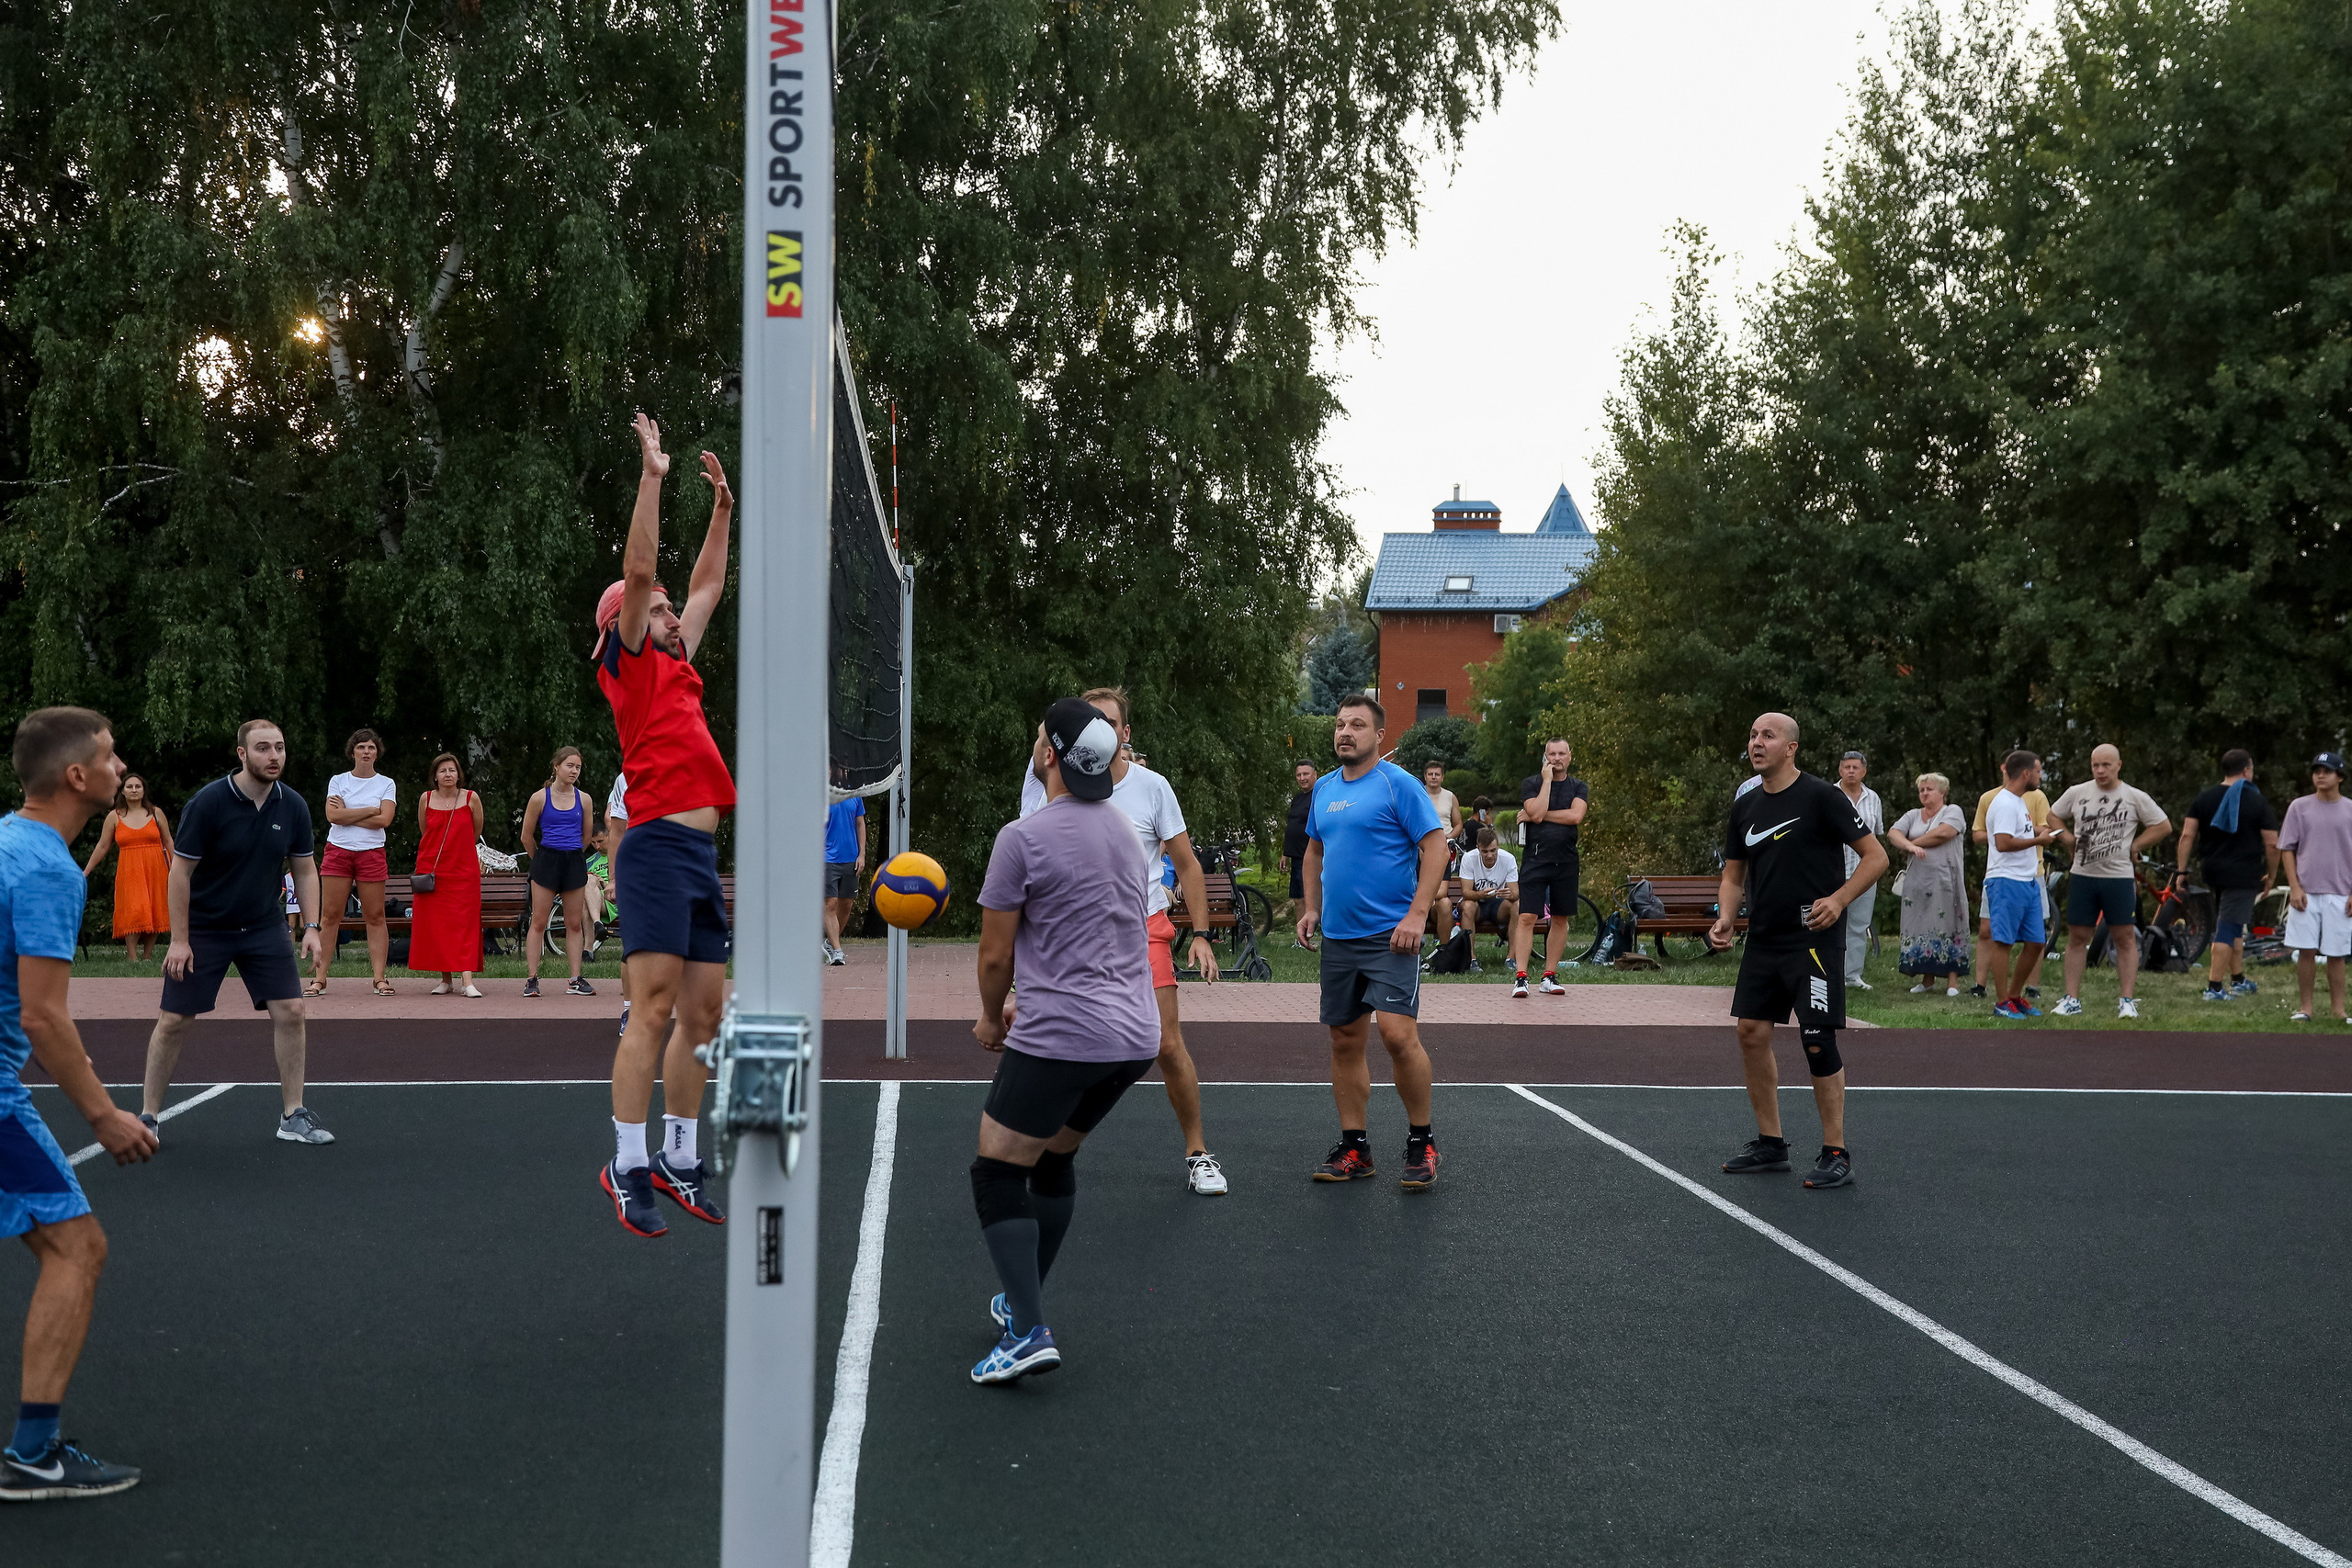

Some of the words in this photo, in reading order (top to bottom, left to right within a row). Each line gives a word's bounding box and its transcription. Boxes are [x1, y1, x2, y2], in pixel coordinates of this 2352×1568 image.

[767, 232, 803, 308] SW
[1326, 799, 1348, 813] RUN
[1810, 975, 1828, 1013] NIKE
